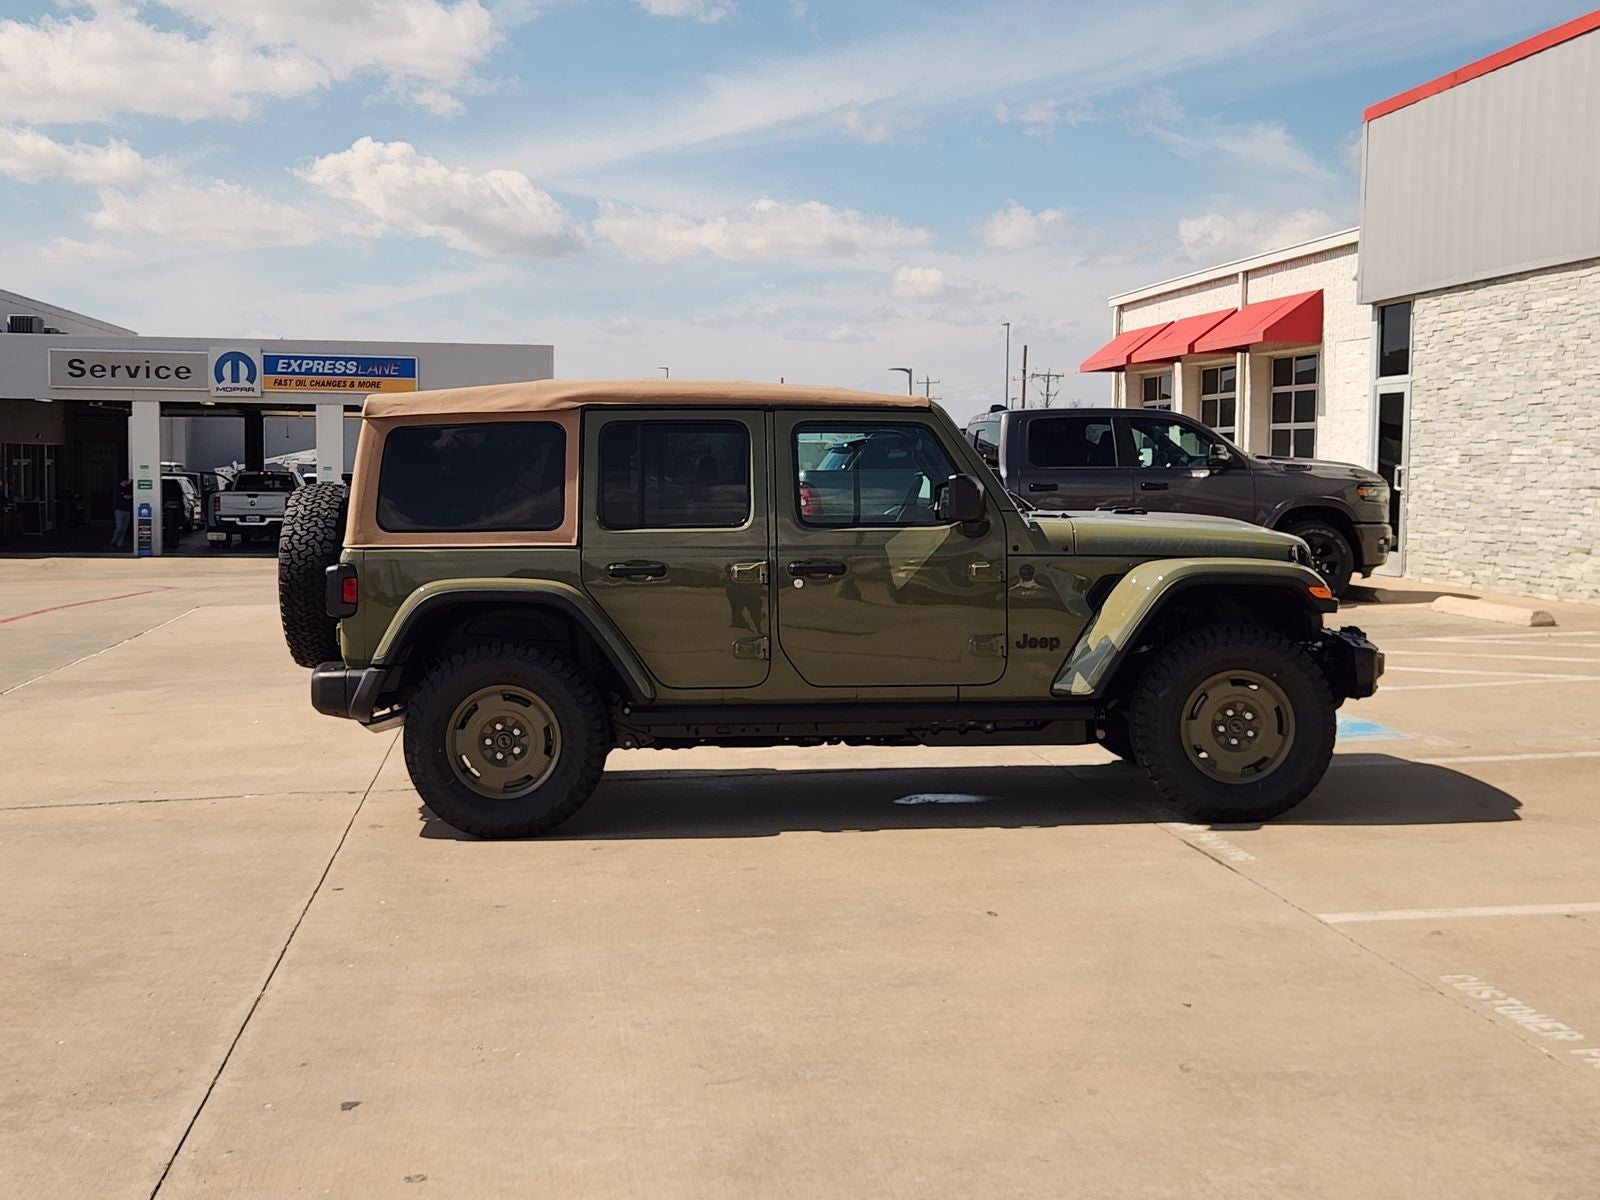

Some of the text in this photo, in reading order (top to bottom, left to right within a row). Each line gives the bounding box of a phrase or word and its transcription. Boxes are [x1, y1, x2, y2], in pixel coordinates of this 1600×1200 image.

[67, 358, 192, 380] Service
[273, 378, 293, 388] FAST
[295, 379, 307, 388] OIL
[310, 379, 347, 389] CHANGES
[358, 381, 381, 389] MORE
[1016, 633, 1061, 651] Jeep
